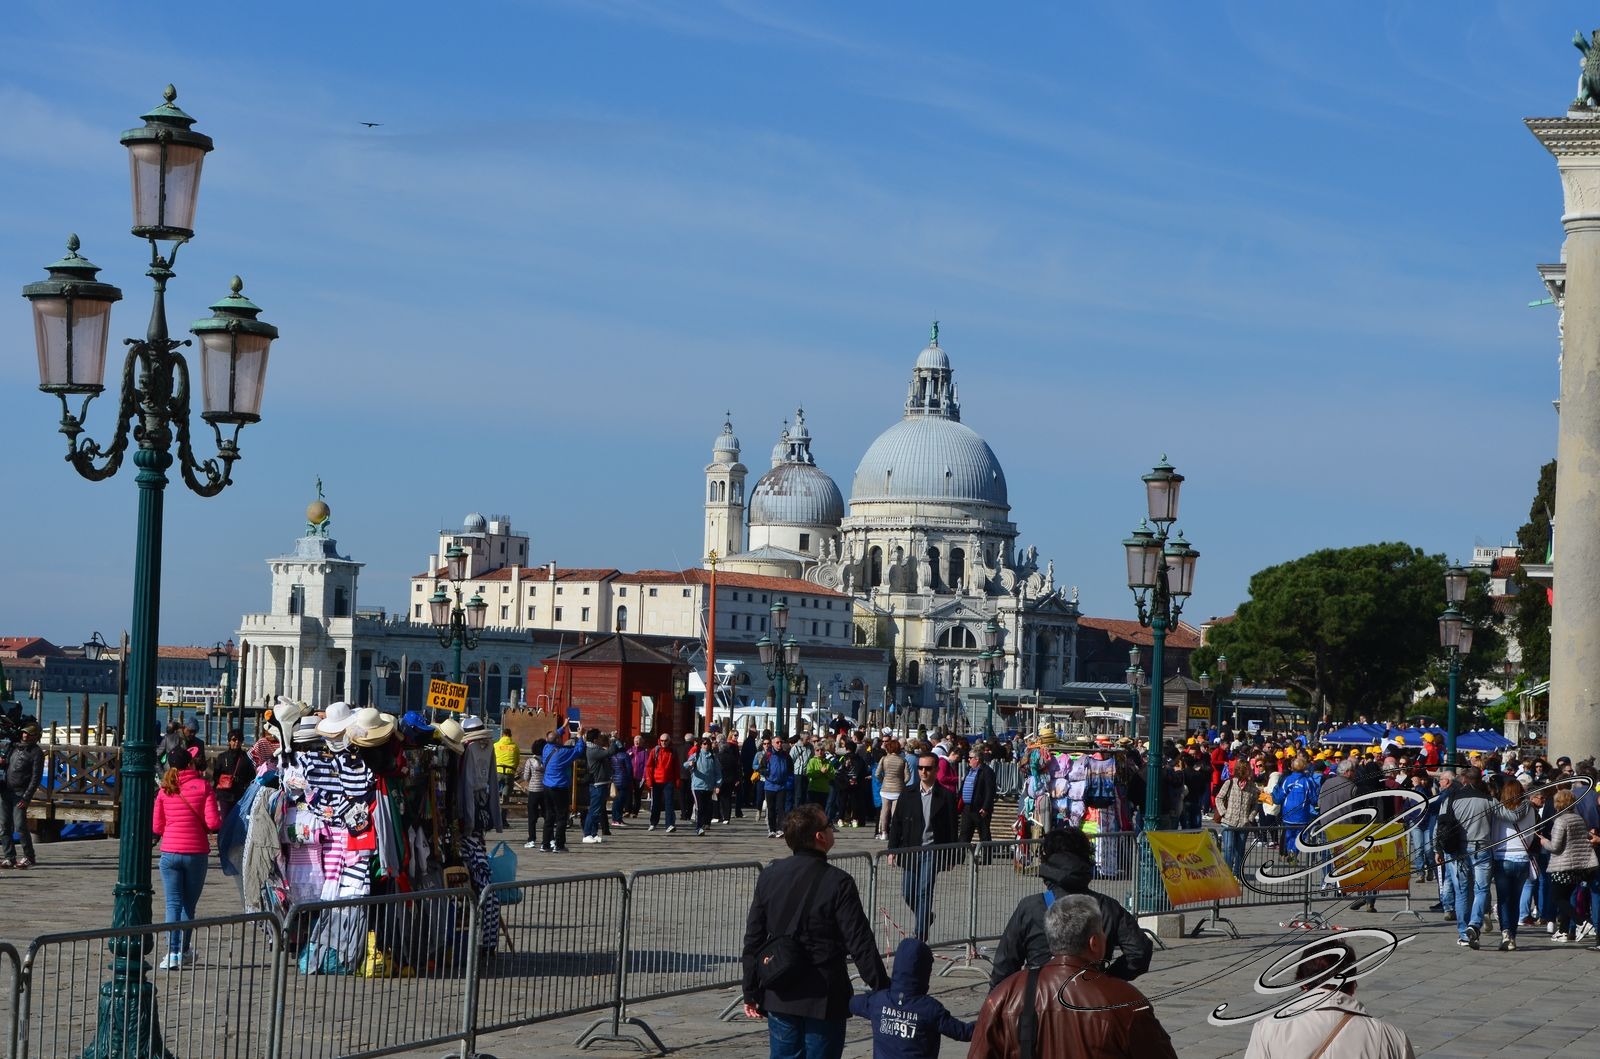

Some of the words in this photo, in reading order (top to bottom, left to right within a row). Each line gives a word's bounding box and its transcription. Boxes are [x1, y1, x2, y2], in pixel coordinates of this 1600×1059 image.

[431, 681, 449, 695] SELFIE
[449, 684, 466, 698] STICK
[1191, 707, 1209, 716] TAXI
